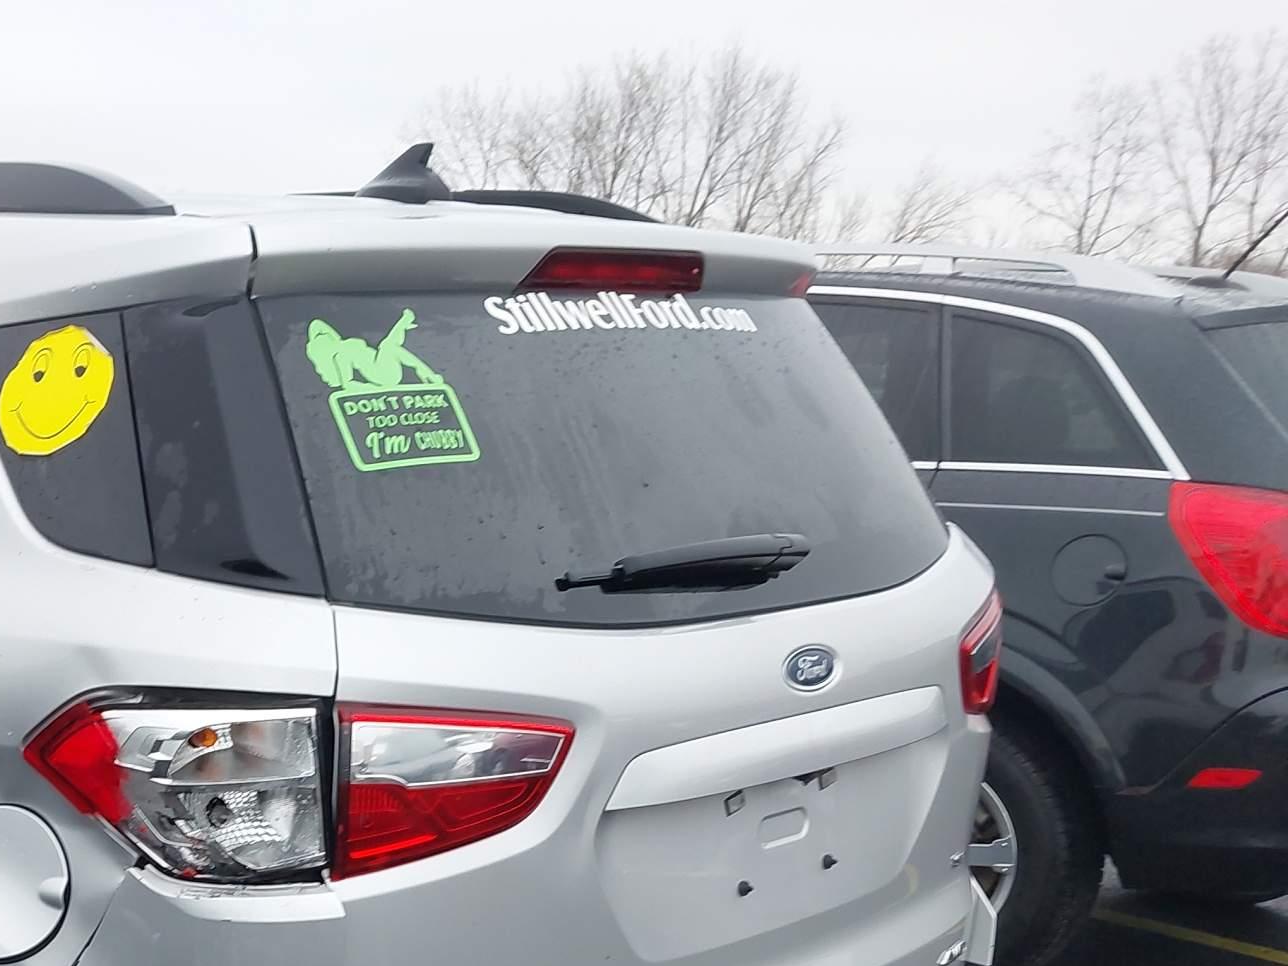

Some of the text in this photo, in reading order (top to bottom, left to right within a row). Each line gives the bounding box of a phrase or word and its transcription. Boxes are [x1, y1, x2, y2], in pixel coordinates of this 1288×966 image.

[484, 291, 757, 334] StillwellFord.com
[343, 393, 449, 416] DON'T PARK
[366, 411, 440, 428] TOO CLOSE
[365, 430, 411, 459] I'm
[796, 655, 828, 681] Ford
